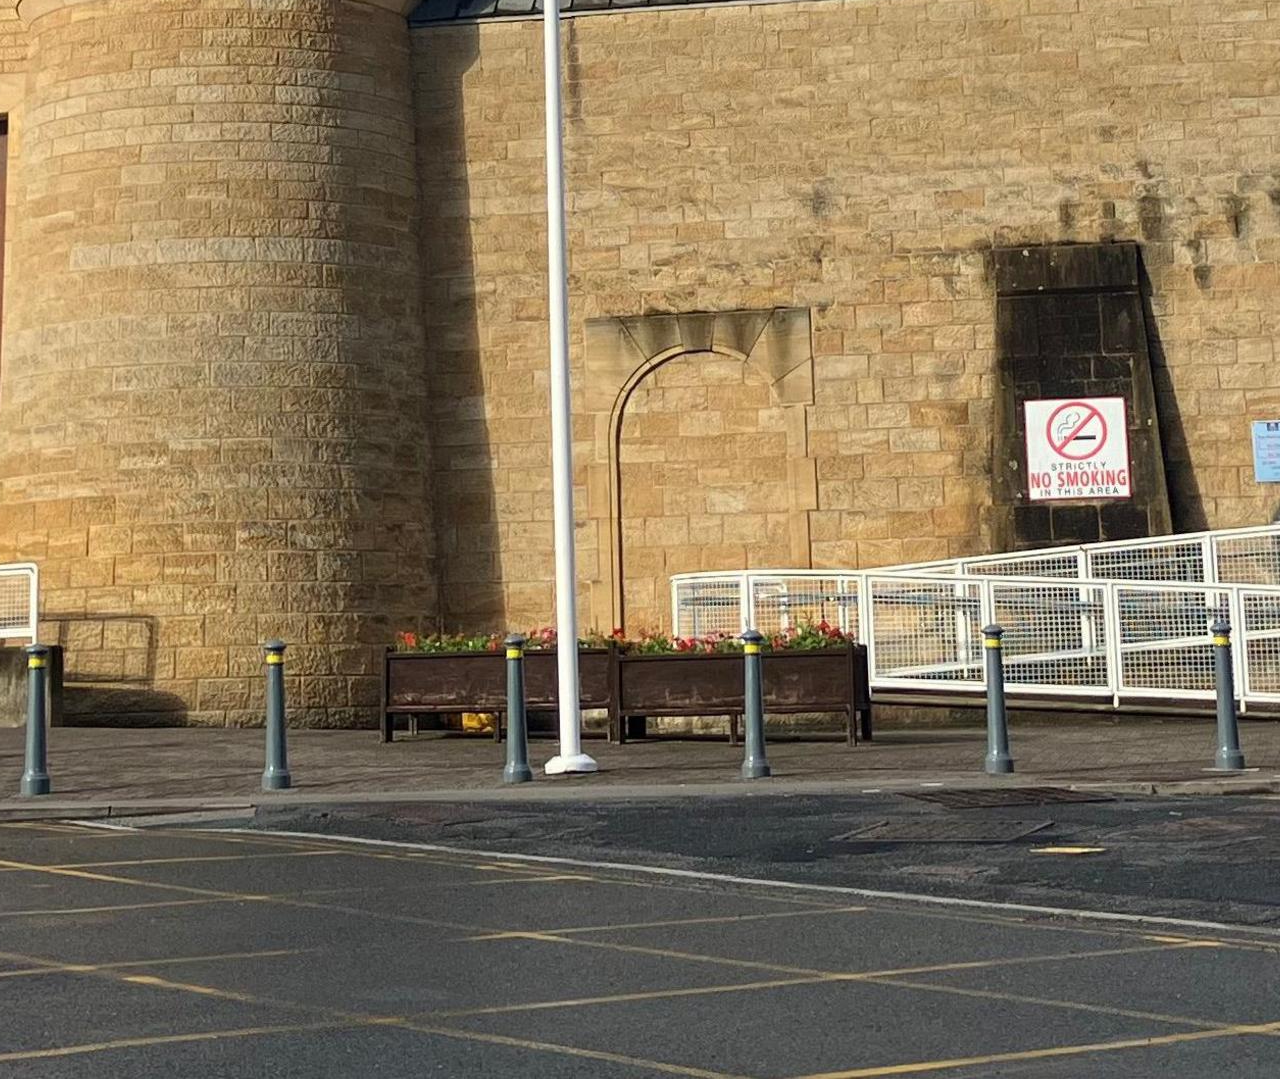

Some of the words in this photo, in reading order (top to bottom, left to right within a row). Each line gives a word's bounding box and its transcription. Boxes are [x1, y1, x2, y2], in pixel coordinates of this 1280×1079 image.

[1051, 461, 1106, 471] STRICTLY
[1031, 472, 1051, 488] NO
[1057, 470, 1127, 487] SMOKING
[1057, 488, 1083, 496] THIS
[1089, 486, 1119, 494] AREA
